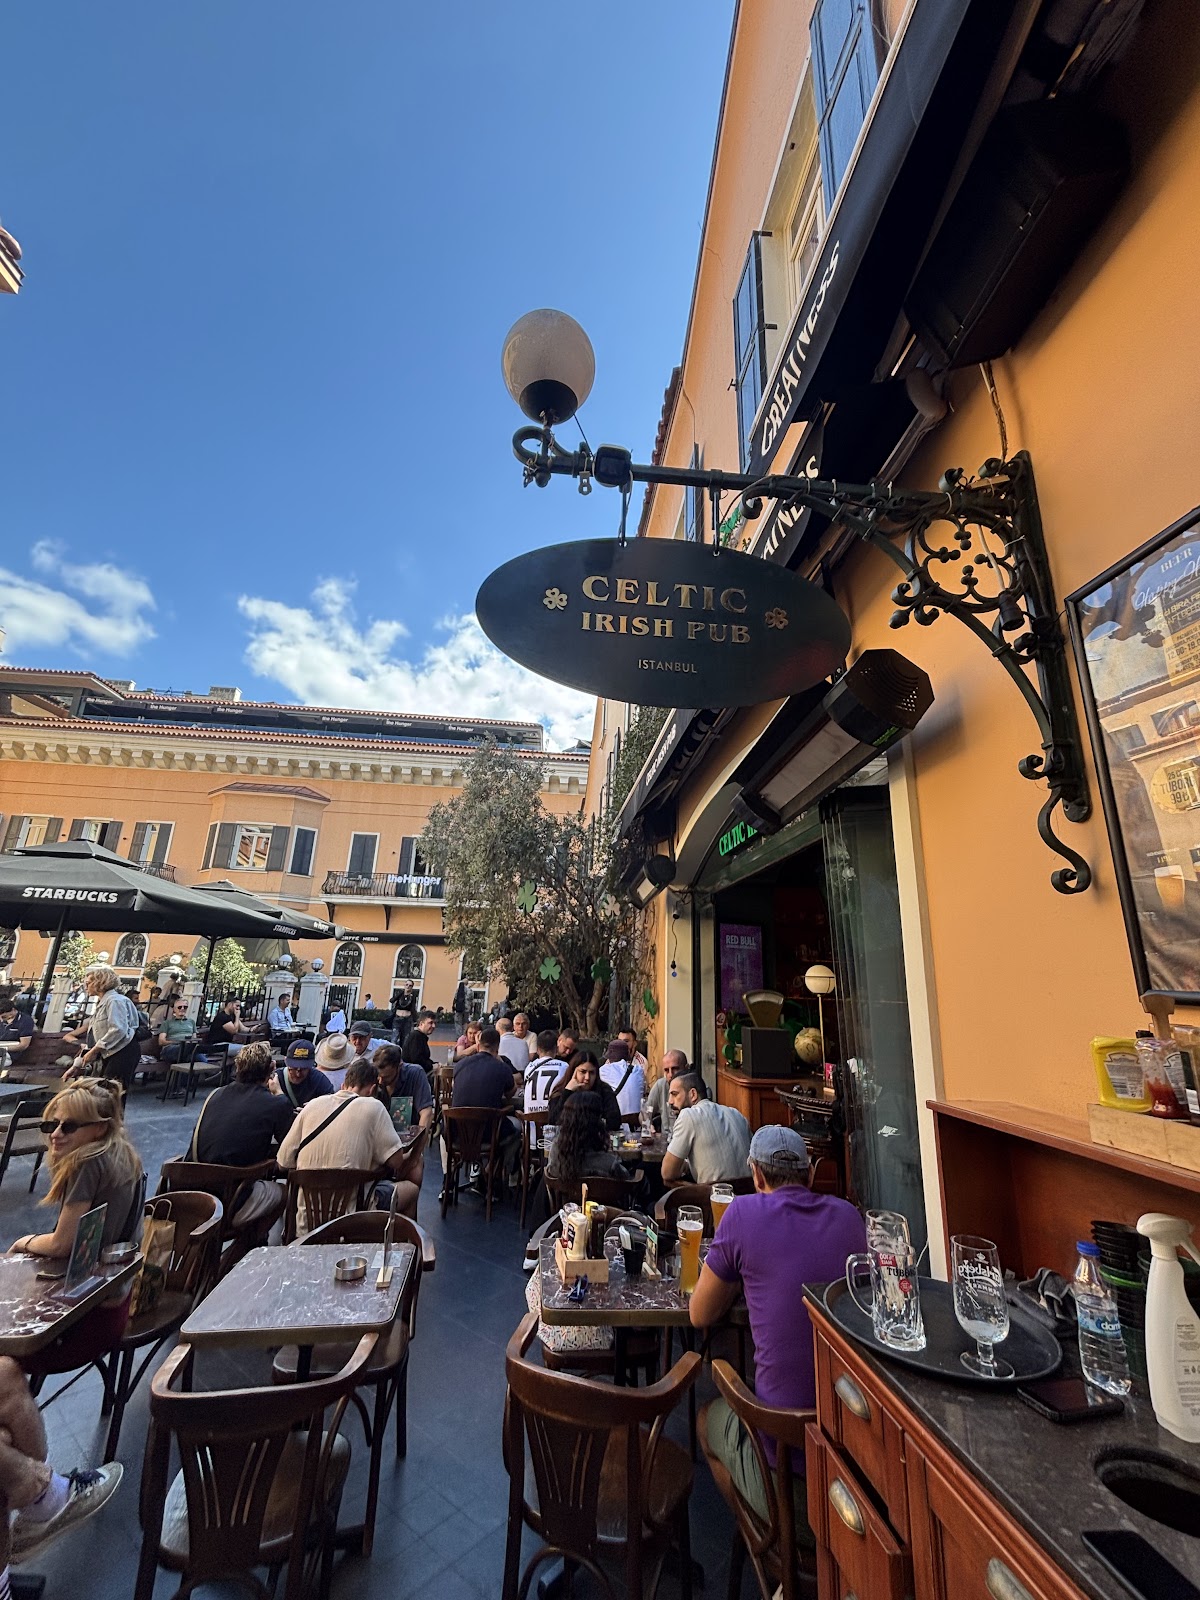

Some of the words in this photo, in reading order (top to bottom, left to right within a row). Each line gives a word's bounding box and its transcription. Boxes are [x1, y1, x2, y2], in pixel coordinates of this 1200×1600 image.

[582, 575, 748, 614] CELTIC
[581, 611, 674, 638] IRISH
[687, 621, 751, 644] PUB
[638, 659, 698, 674] ISTANBUL
[719, 821, 746, 856] CELTIC
[22, 887, 118, 903] STARBUCKS
[725, 934, 738, 945] RED
[740, 935, 756, 946] BULL
[528, 1070, 560, 1100] 17
[1101, 1320, 1121, 1331] dam
